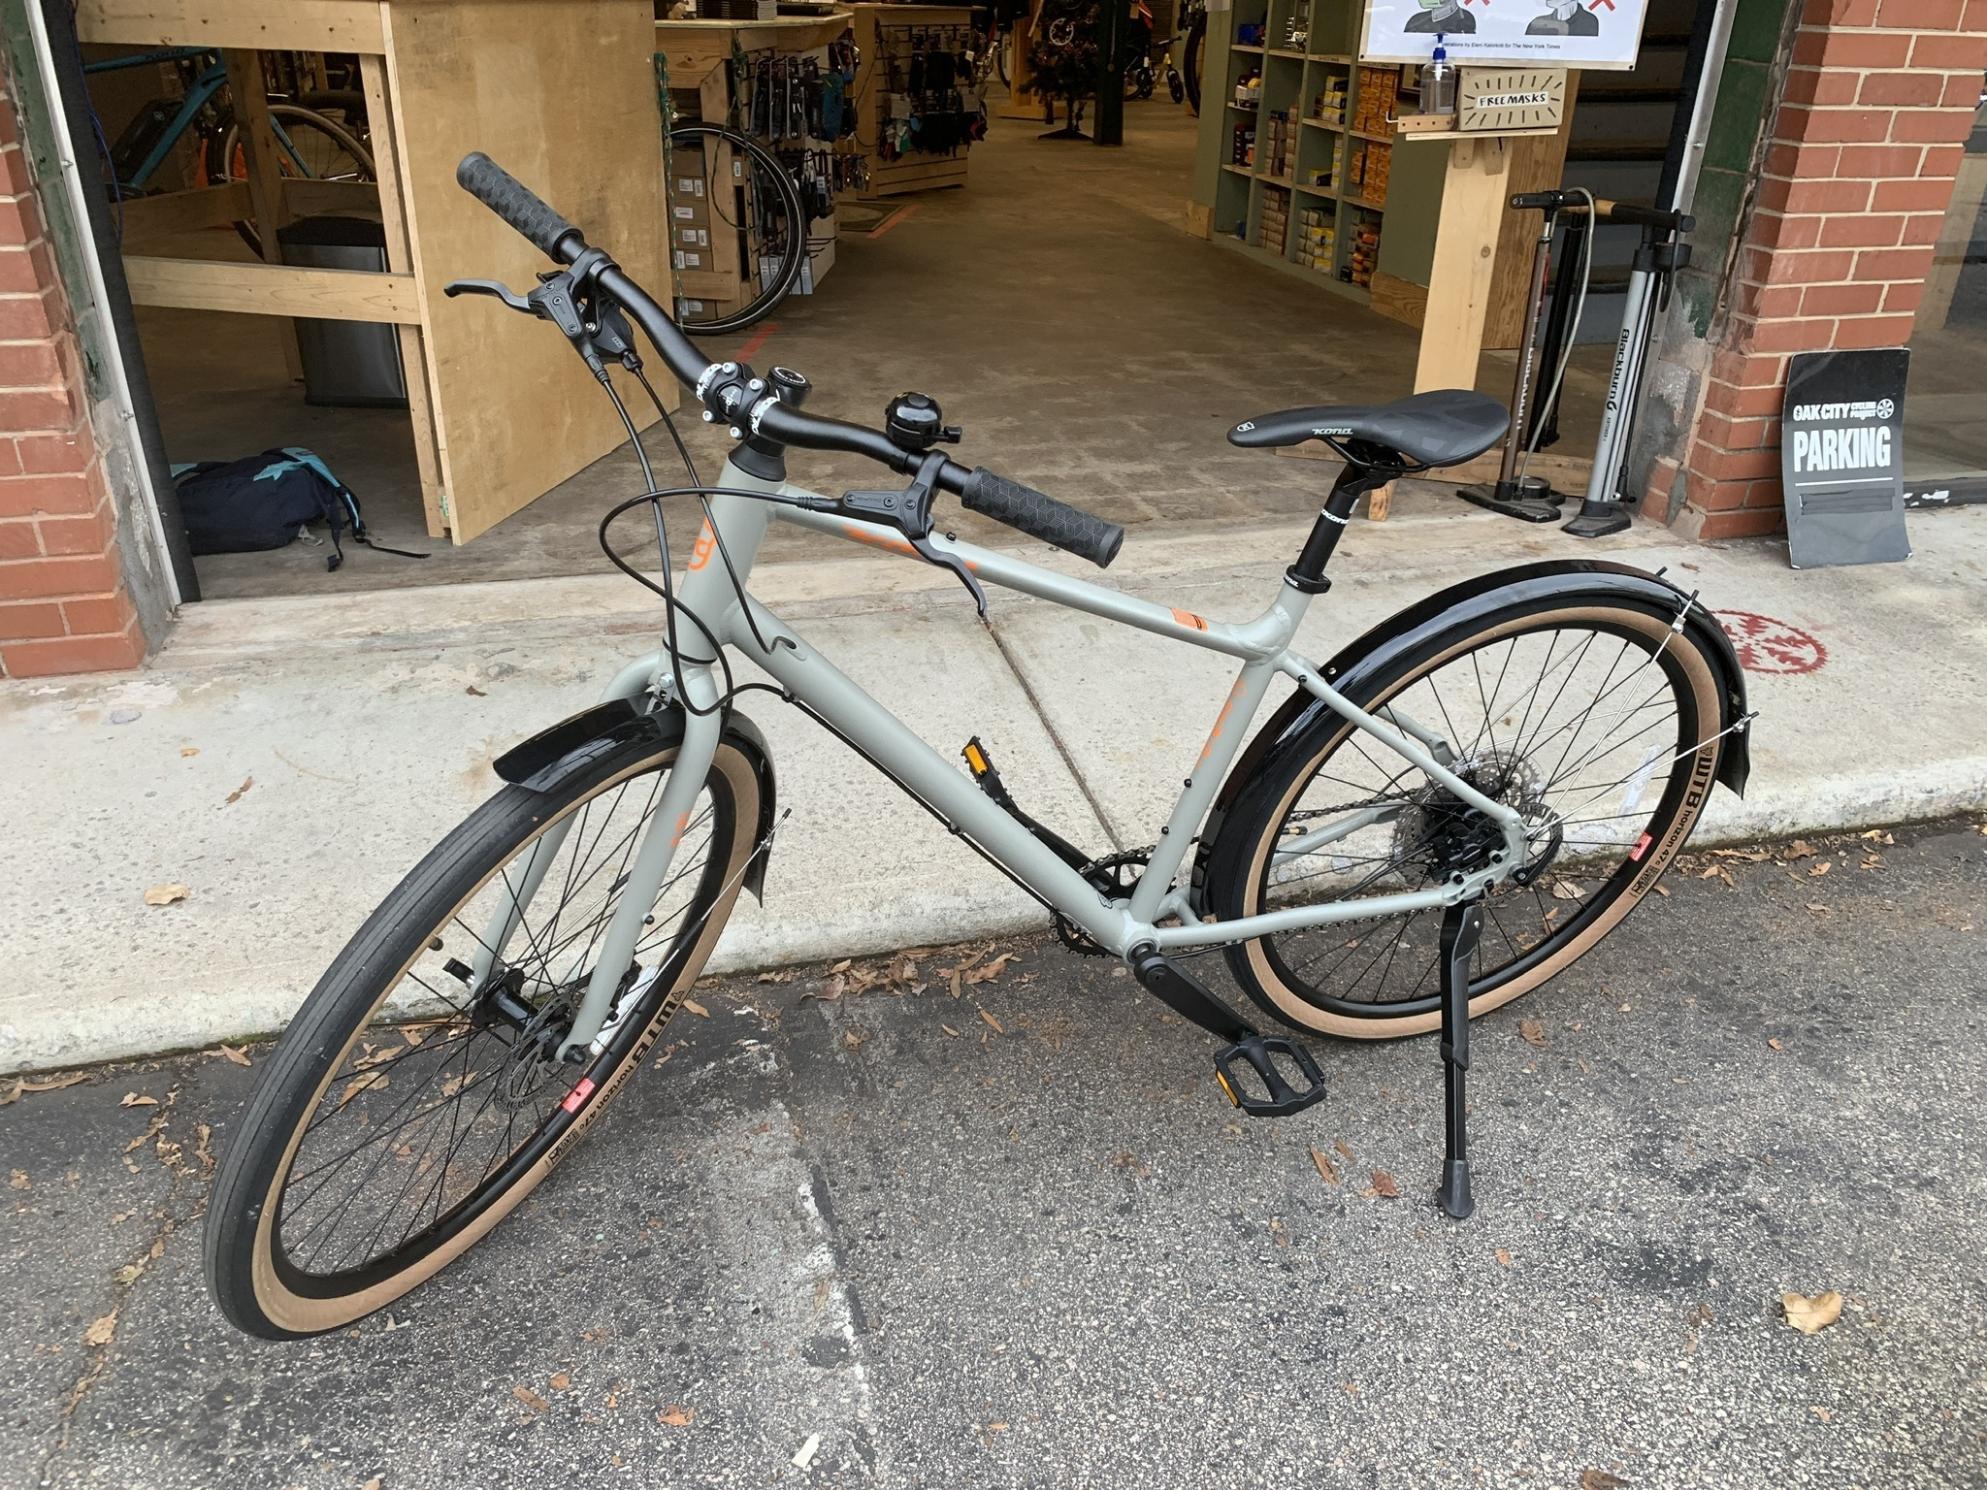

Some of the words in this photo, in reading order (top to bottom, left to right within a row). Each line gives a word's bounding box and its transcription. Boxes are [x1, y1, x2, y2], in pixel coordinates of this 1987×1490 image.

[1609, 328, 1630, 399] Blackburn
[1793, 404, 1821, 421] OAK
[1821, 402, 1850, 420] CITY
[1793, 425, 1891, 472] PARKING
[1686, 757, 1713, 809] WTB
[1668, 810, 1693, 848] horizon
[632, 1000, 678, 1064] WTB
[597, 1064, 634, 1110] horizon
